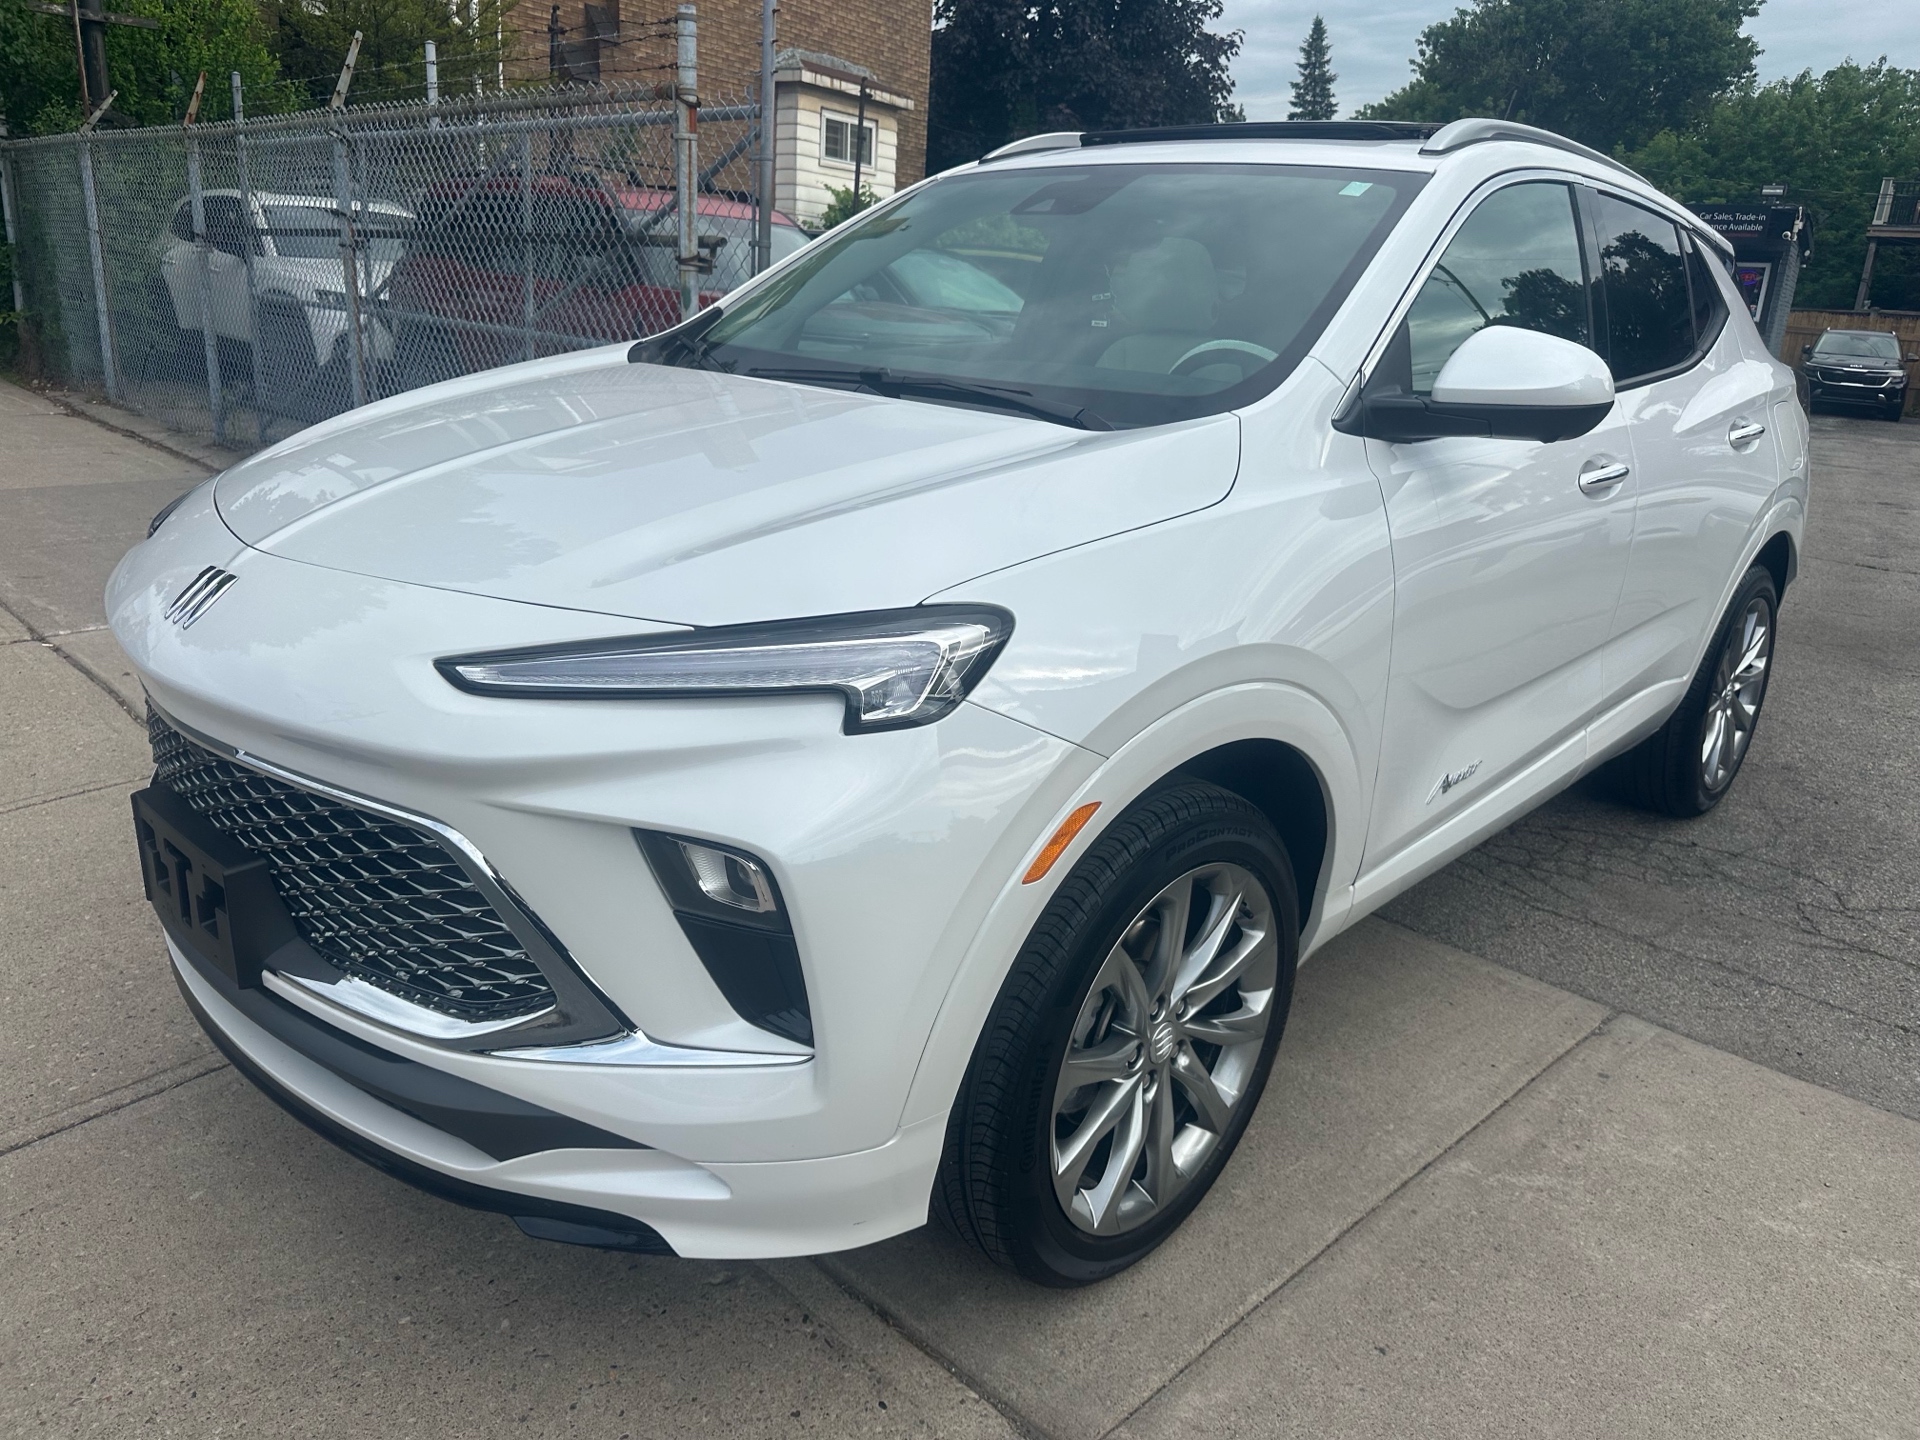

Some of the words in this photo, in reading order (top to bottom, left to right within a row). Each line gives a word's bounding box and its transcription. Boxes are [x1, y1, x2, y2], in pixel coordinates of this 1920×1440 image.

[1700, 212, 1712, 220] Car
[1713, 212, 1733, 221] Sales,
[1735, 212, 1766, 221] Trade-in
[1729, 223, 1763, 231] Available
